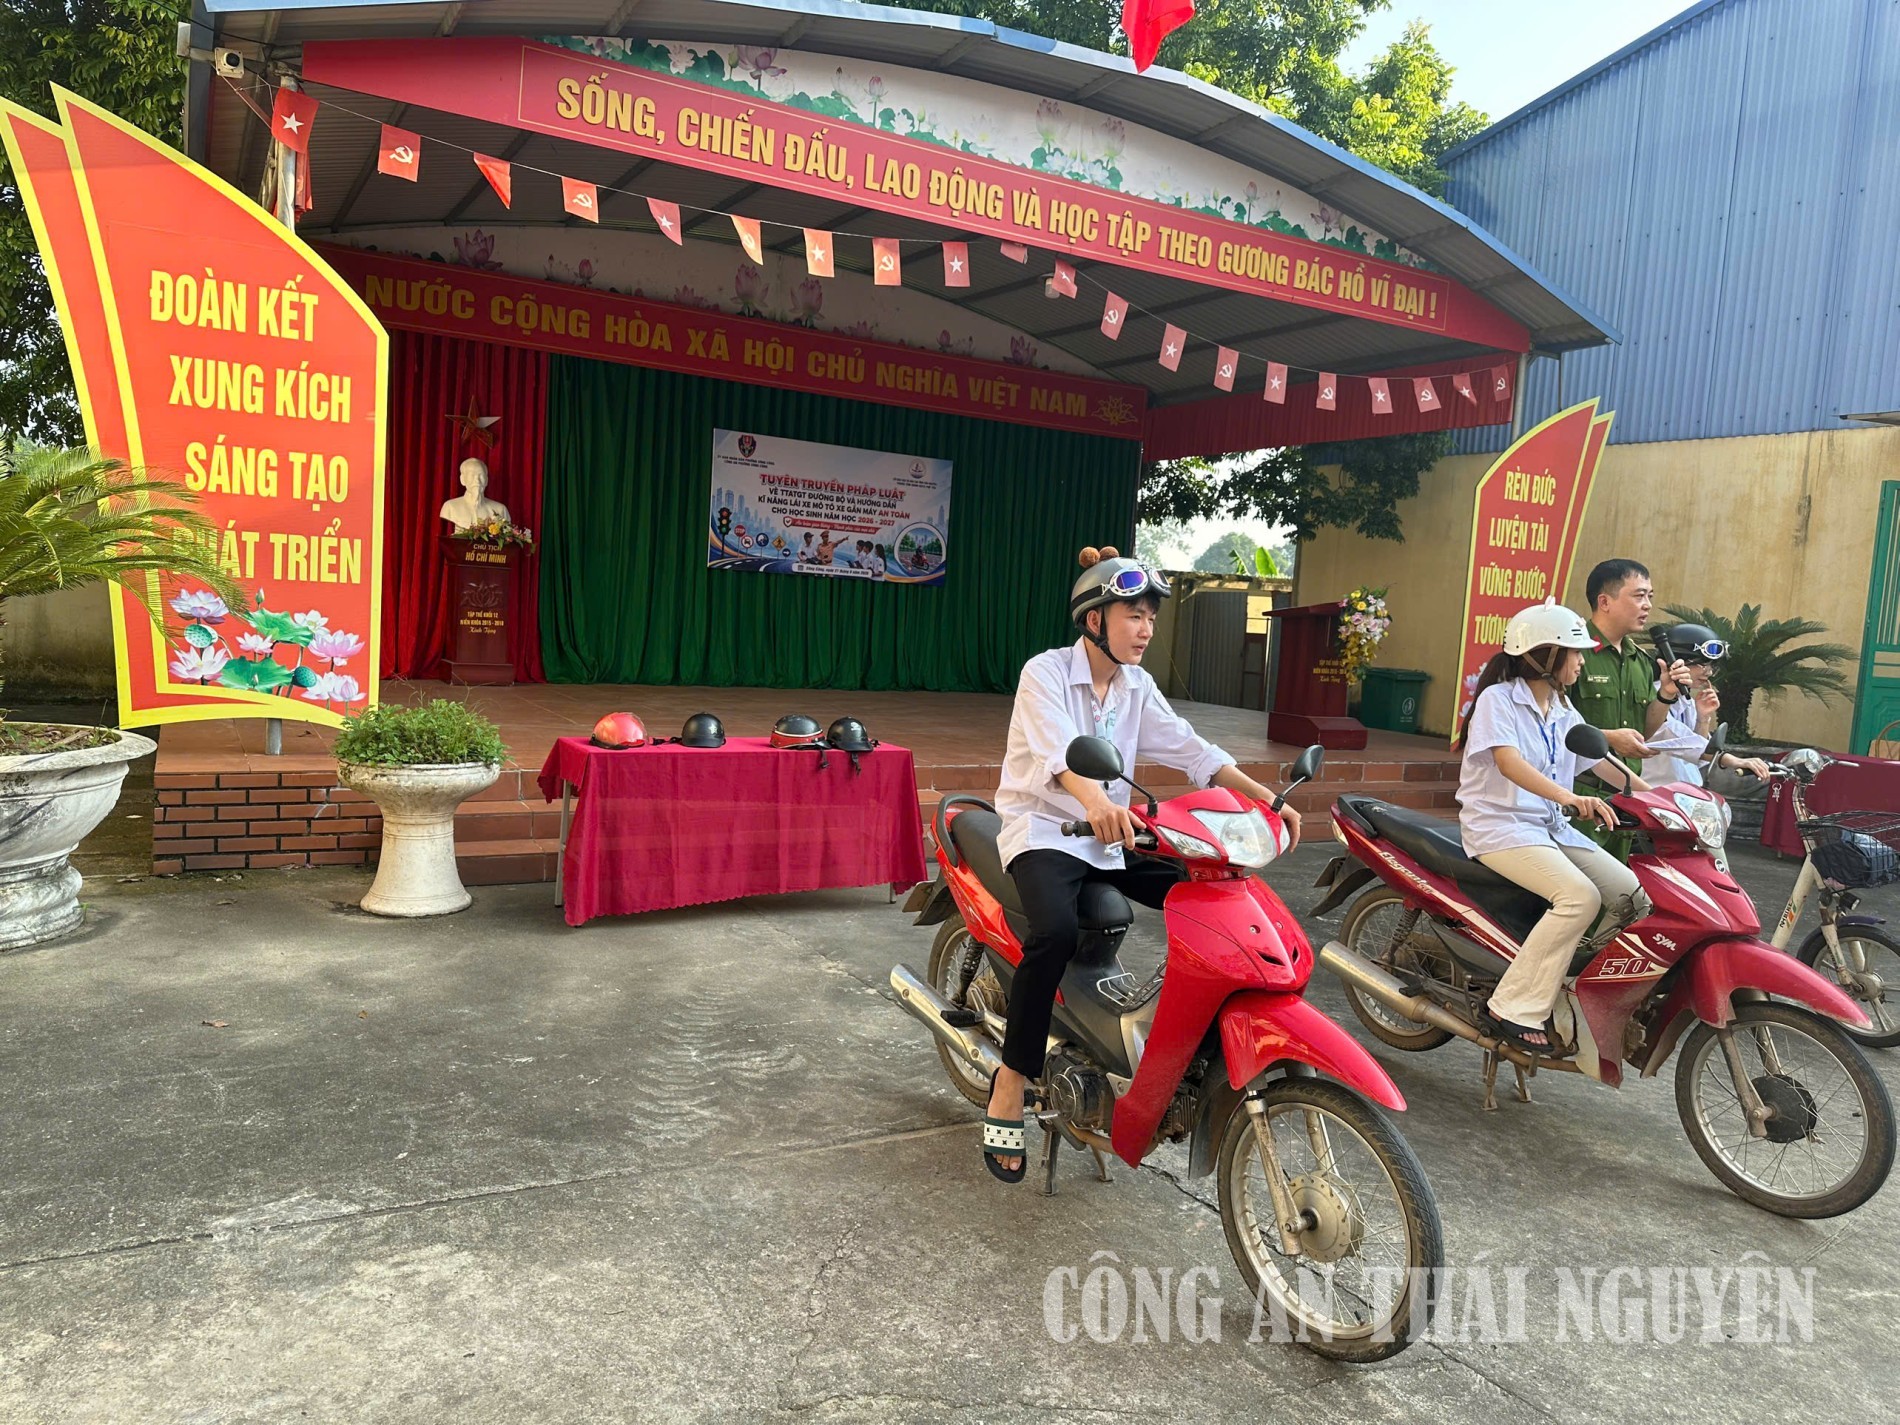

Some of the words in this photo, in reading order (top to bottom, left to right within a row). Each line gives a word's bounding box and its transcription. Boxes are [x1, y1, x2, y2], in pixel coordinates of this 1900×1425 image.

[557, 72, 666, 146] SỐNG,
[677, 107, 775, 167] CHIẾN
[784, 127, 854, 189] ĐẤU,
[865, 153, 921, 200] LAO
[929, 166, 1003, 221] ĐỘNG
[1012, 189, 1042, 229] VÀ
[1049, 201, 1099, 245] HỌC
[1106, 210, 1151, 257] TẬP
[1158, 226, 1212, 269] THEO
[1218, 242, 1290, 287] GƯƠNG
[1294, 252, 1334, 298] BÁC
[1338, 262, 1366, 303] HỒ
[1370, 274, 1392, 307] VĨ
[1394, 283, 1425, 321] ĐẠI
[149, 267, 247, 334] ĐOÀN
[258, 274, 319, 342] KẾT
[365, 274, 475, 320] NƯỚC
[490, 292, 591, 339] CỘNG
[605, 309, 673, 353] HÒA
[687, 327, 731, 362] XÃ
[743, 337, 794, 376] HỘI
[807, 346, 866, 384] CHỦ
[875, 362, 959, 400] NGHĨA
[968, 375, 1021, 411] VIỆT
[1029, 387, 1088, 418] NAM
[169, 354, 264, 415] XUNG
[275, 360, 351, 424] KÍCH
[184, 434, 277, 498] SÁNG
[289, 454, 349, 511] TẠO
[759, 473, 799, 489] TUYÊN
[847, 483, 877, 498] PHÁP
[878, 487, 906, 501] LUẬT
[1504, 466, 1530, 502] RÈN
[1531, 468, 1557, 507] ĐỨC
[767, 496, 788, 506] NĂNG
[789, 498, 801, 507] LÁI
[802, 500, 811, 509] XE
[812, 501, 824, 510] MÔ
[836, 504, 845, 512] XE
[862, 507, 878, 516] MÁY
[878, 509, 889, 517] AN
[780, 489, 807, 499] TTATGT
[771, 506, 788, 515] CHO
[789, 508, 804, 517] HỌC
[805, 510, 822, 519] SINH
[841, 514, 856, 523] HỌC
[270, 518, 362, 584] TRIỂN
[473, 542, 486, 550] CHỦ
[1489, 514, 1528, 555] LUYỆN
[1530, 517, 1550, 552] TÀI
[465, 549, 475, 561] HỒ
[476, 551, 488, 562] CHÍ
[489, 553, 507, 564] MINH
[1479, 562, 1512, 598] VỮNG
[1513, 566, 1546, 600] BƯỚC
[1474, 613, 1512, 645] TƯƠN
[1379, 851, 1428, 884] Elegant
[1652, 933, 1677, 951] SYM
[1599, 957, 1652, 977] 50
